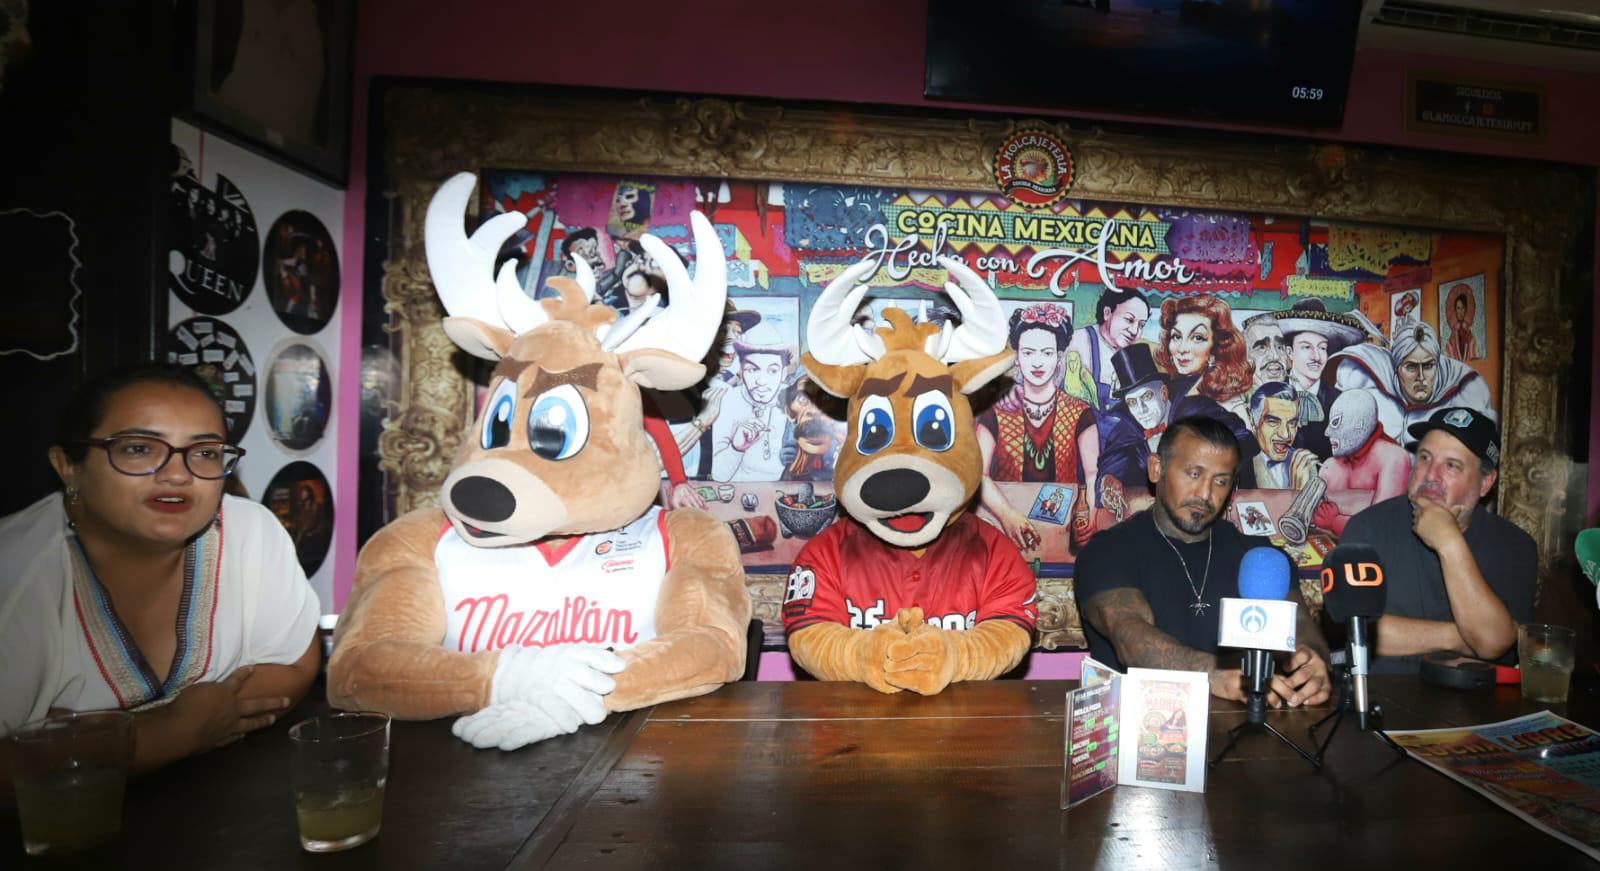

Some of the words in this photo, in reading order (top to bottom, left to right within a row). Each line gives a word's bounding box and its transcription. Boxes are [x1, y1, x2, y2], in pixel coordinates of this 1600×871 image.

[1292, 86, 1324, 100] 05:59
[897, 209, 1005, 239] COCINA
[1013, 216, 1156, 249] MEXICANA
[976, 254, 1020, 273] con
[1026, 218, 1196, 297] Amor
[454, 593, 639, 652] Mazatlán
